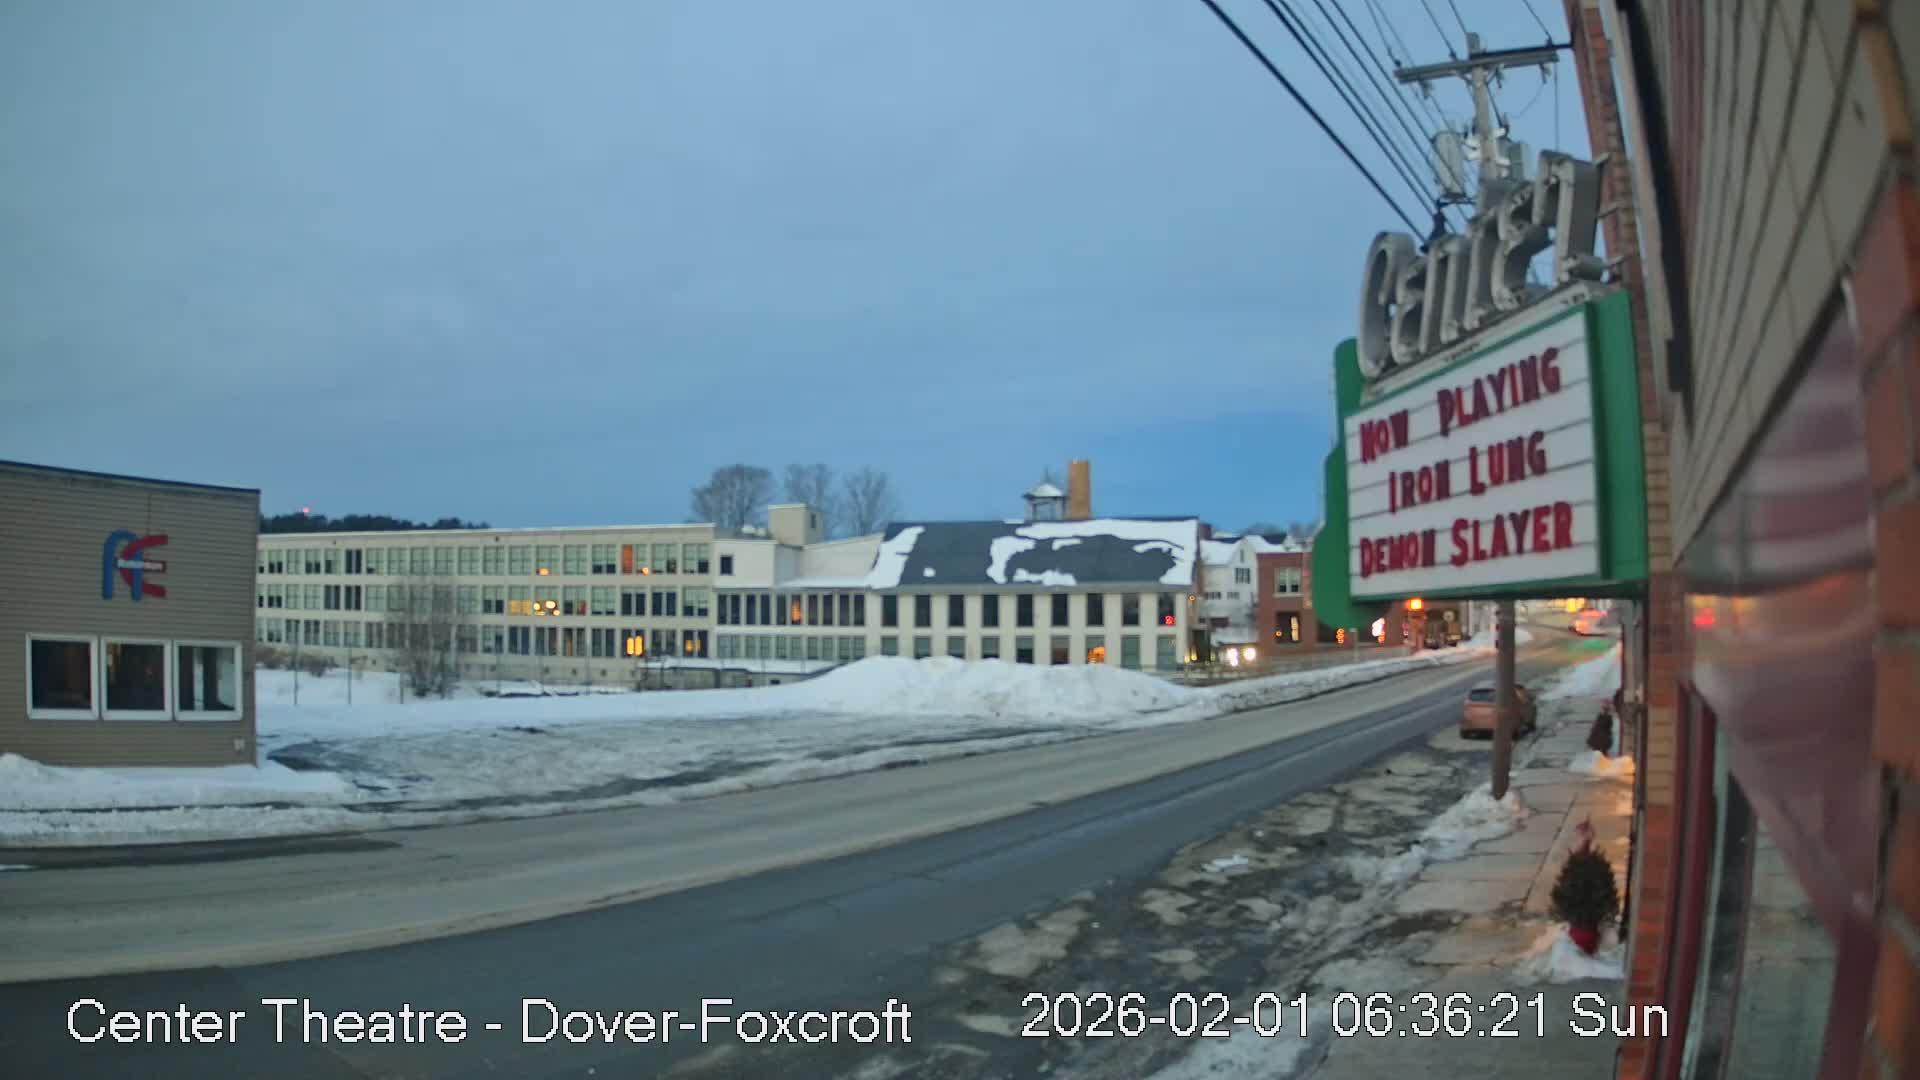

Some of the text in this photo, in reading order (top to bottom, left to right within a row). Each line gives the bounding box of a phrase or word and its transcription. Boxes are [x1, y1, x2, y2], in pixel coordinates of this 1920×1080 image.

[1359, 346, 1560, 463] NOW PLAYING
[1388, 430, 1547, 513] IRON LUNG
[1359, 501, 1573, 578] DEMON SLAYER
